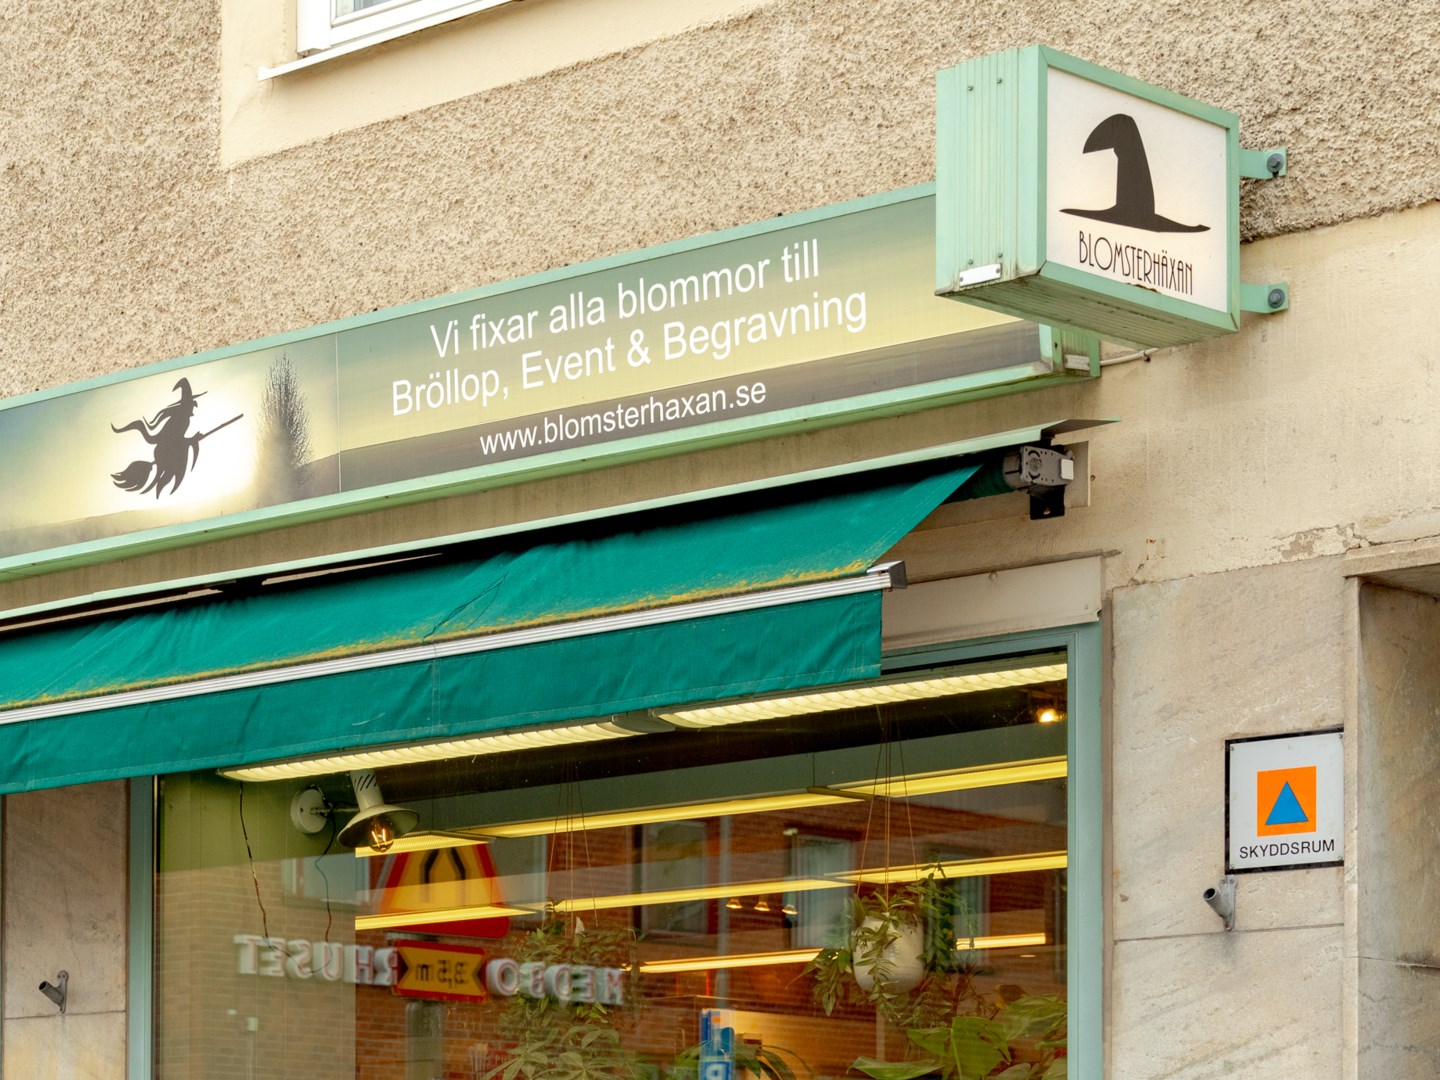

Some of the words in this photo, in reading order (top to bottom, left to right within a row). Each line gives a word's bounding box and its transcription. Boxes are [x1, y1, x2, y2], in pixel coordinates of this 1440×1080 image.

[430, 320, 459, 358] Vi
[470, 310, 538, 351] fixar
[549, 285, 606, 334] alla
[618, 258, 770, 319] blommor
[781, 239, 819, 283] till
[1079, 230, 1193, 296] BLOMSTERHÄXAN
[392, 367, 509, 416] Bröllop,
[522, 336, 616, 390] Event
[627, 328, 651, 368] &
[663, 291, 867, 361] Begravning
[480, 381, 767, 455] www.blomsterhaxan.se
[1239, 838, 1335, 859] SKYDDSRUM
